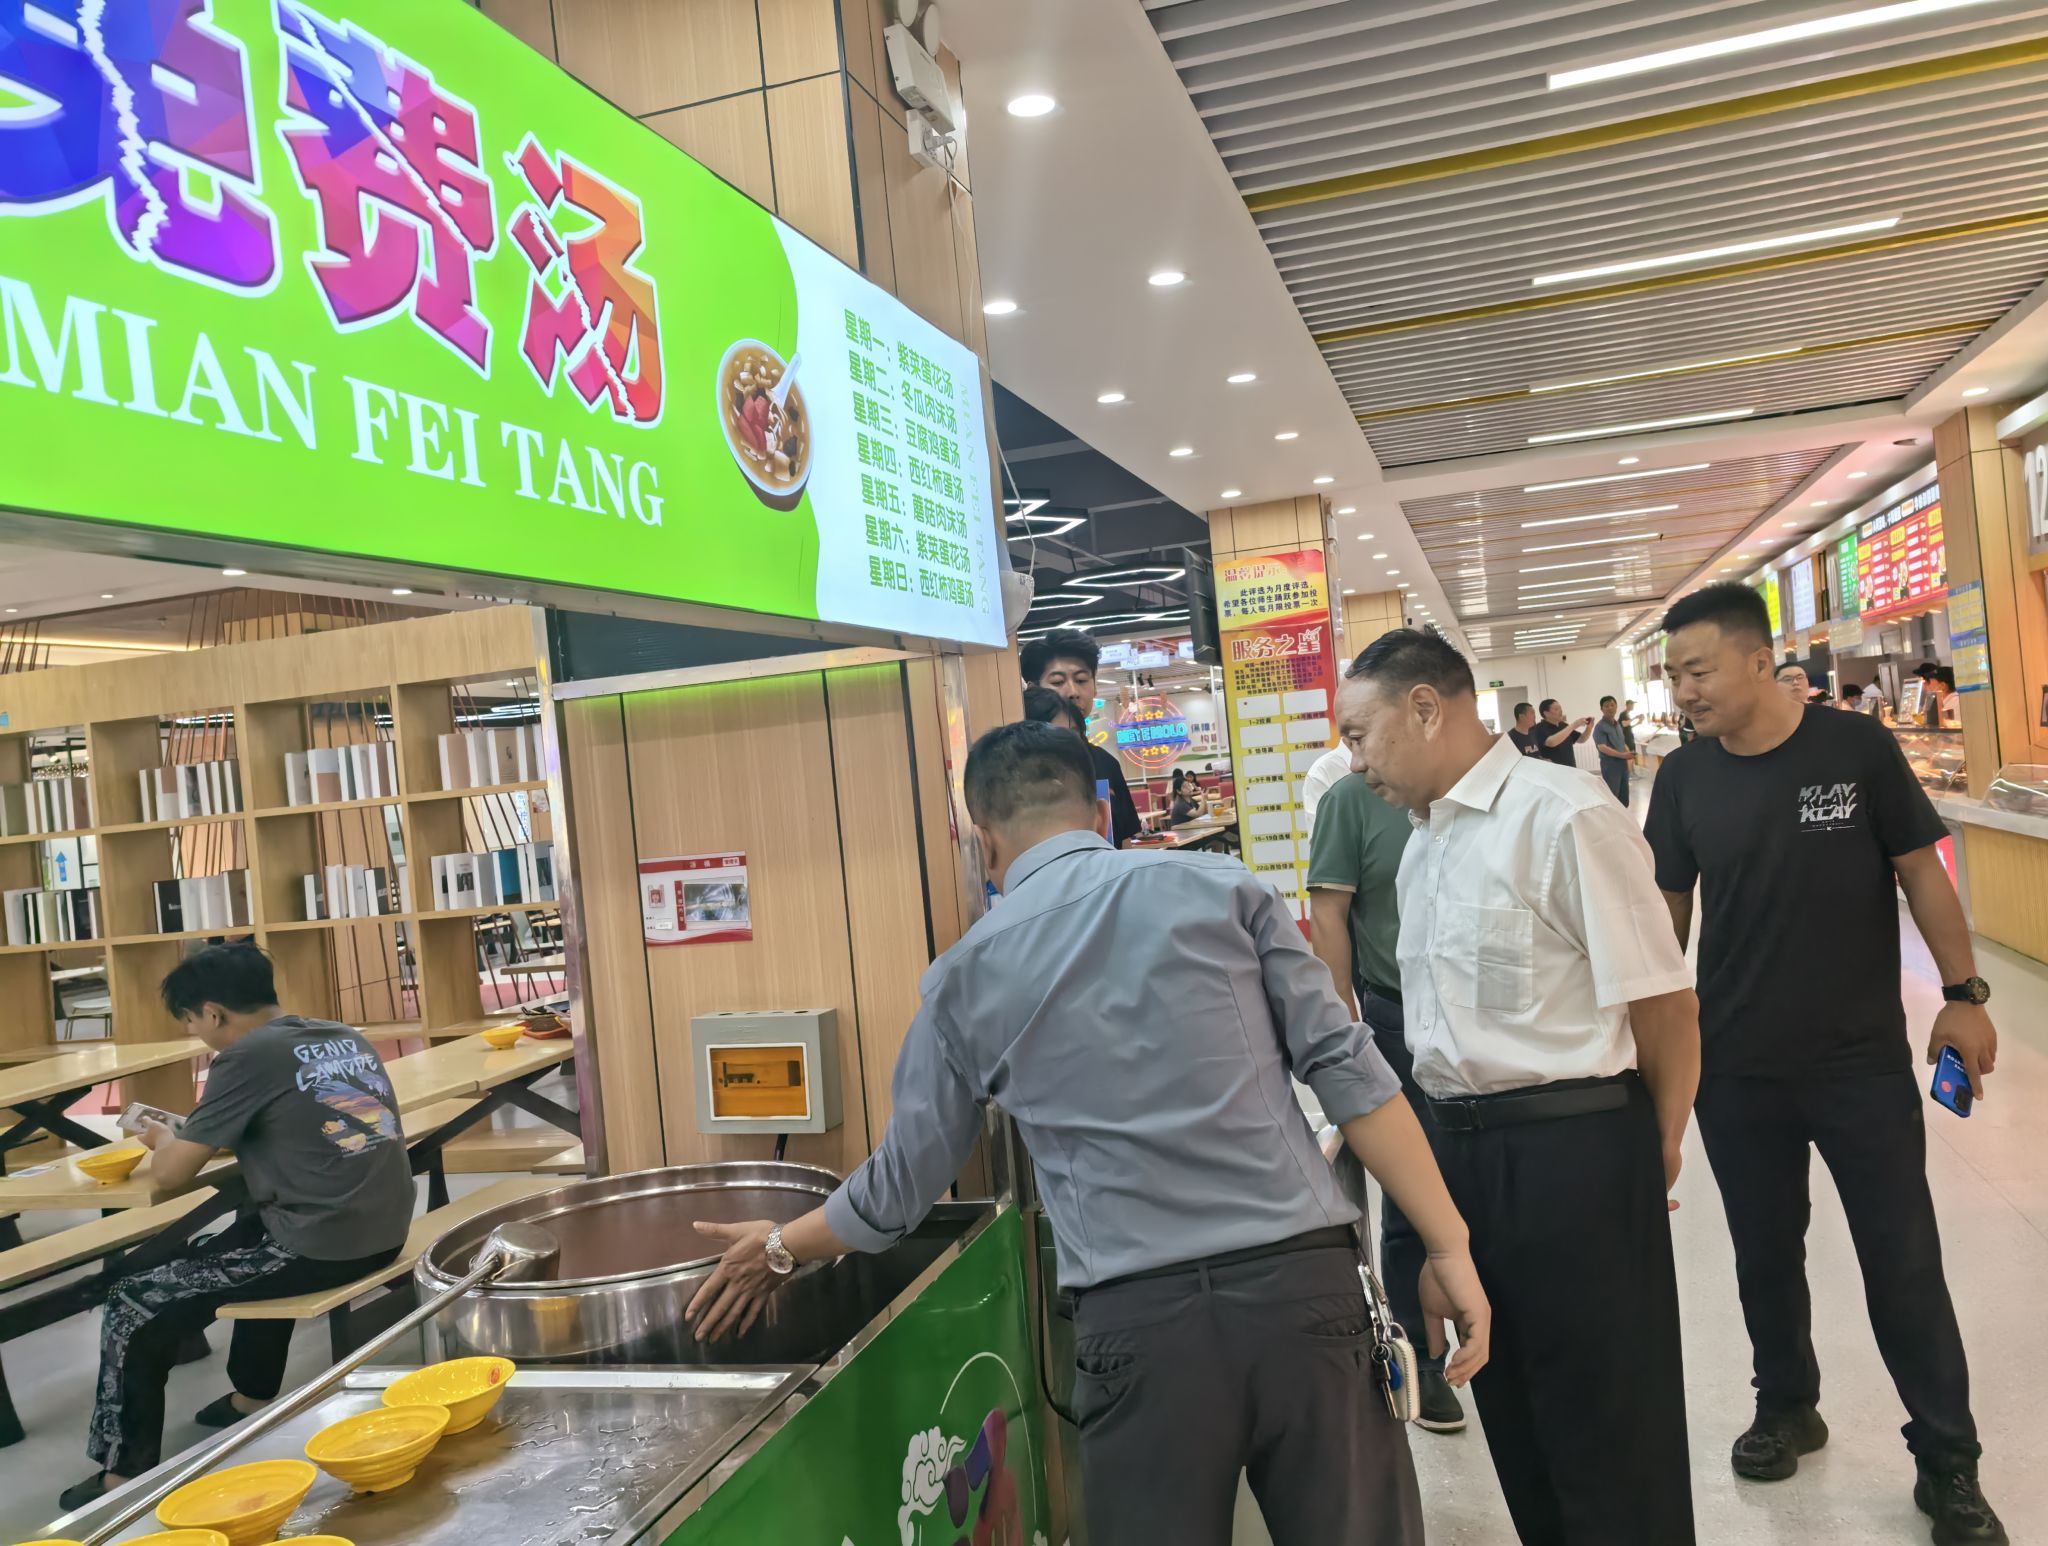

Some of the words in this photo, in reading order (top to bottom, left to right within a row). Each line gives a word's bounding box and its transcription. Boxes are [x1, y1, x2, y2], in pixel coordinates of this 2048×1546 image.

[0, 275, 316, 450] MIAN
[343, 375, 486, 487] FEI
[500, 421, 664, 527] TANG
[1231, 626, 1322, 661] 服务之星
